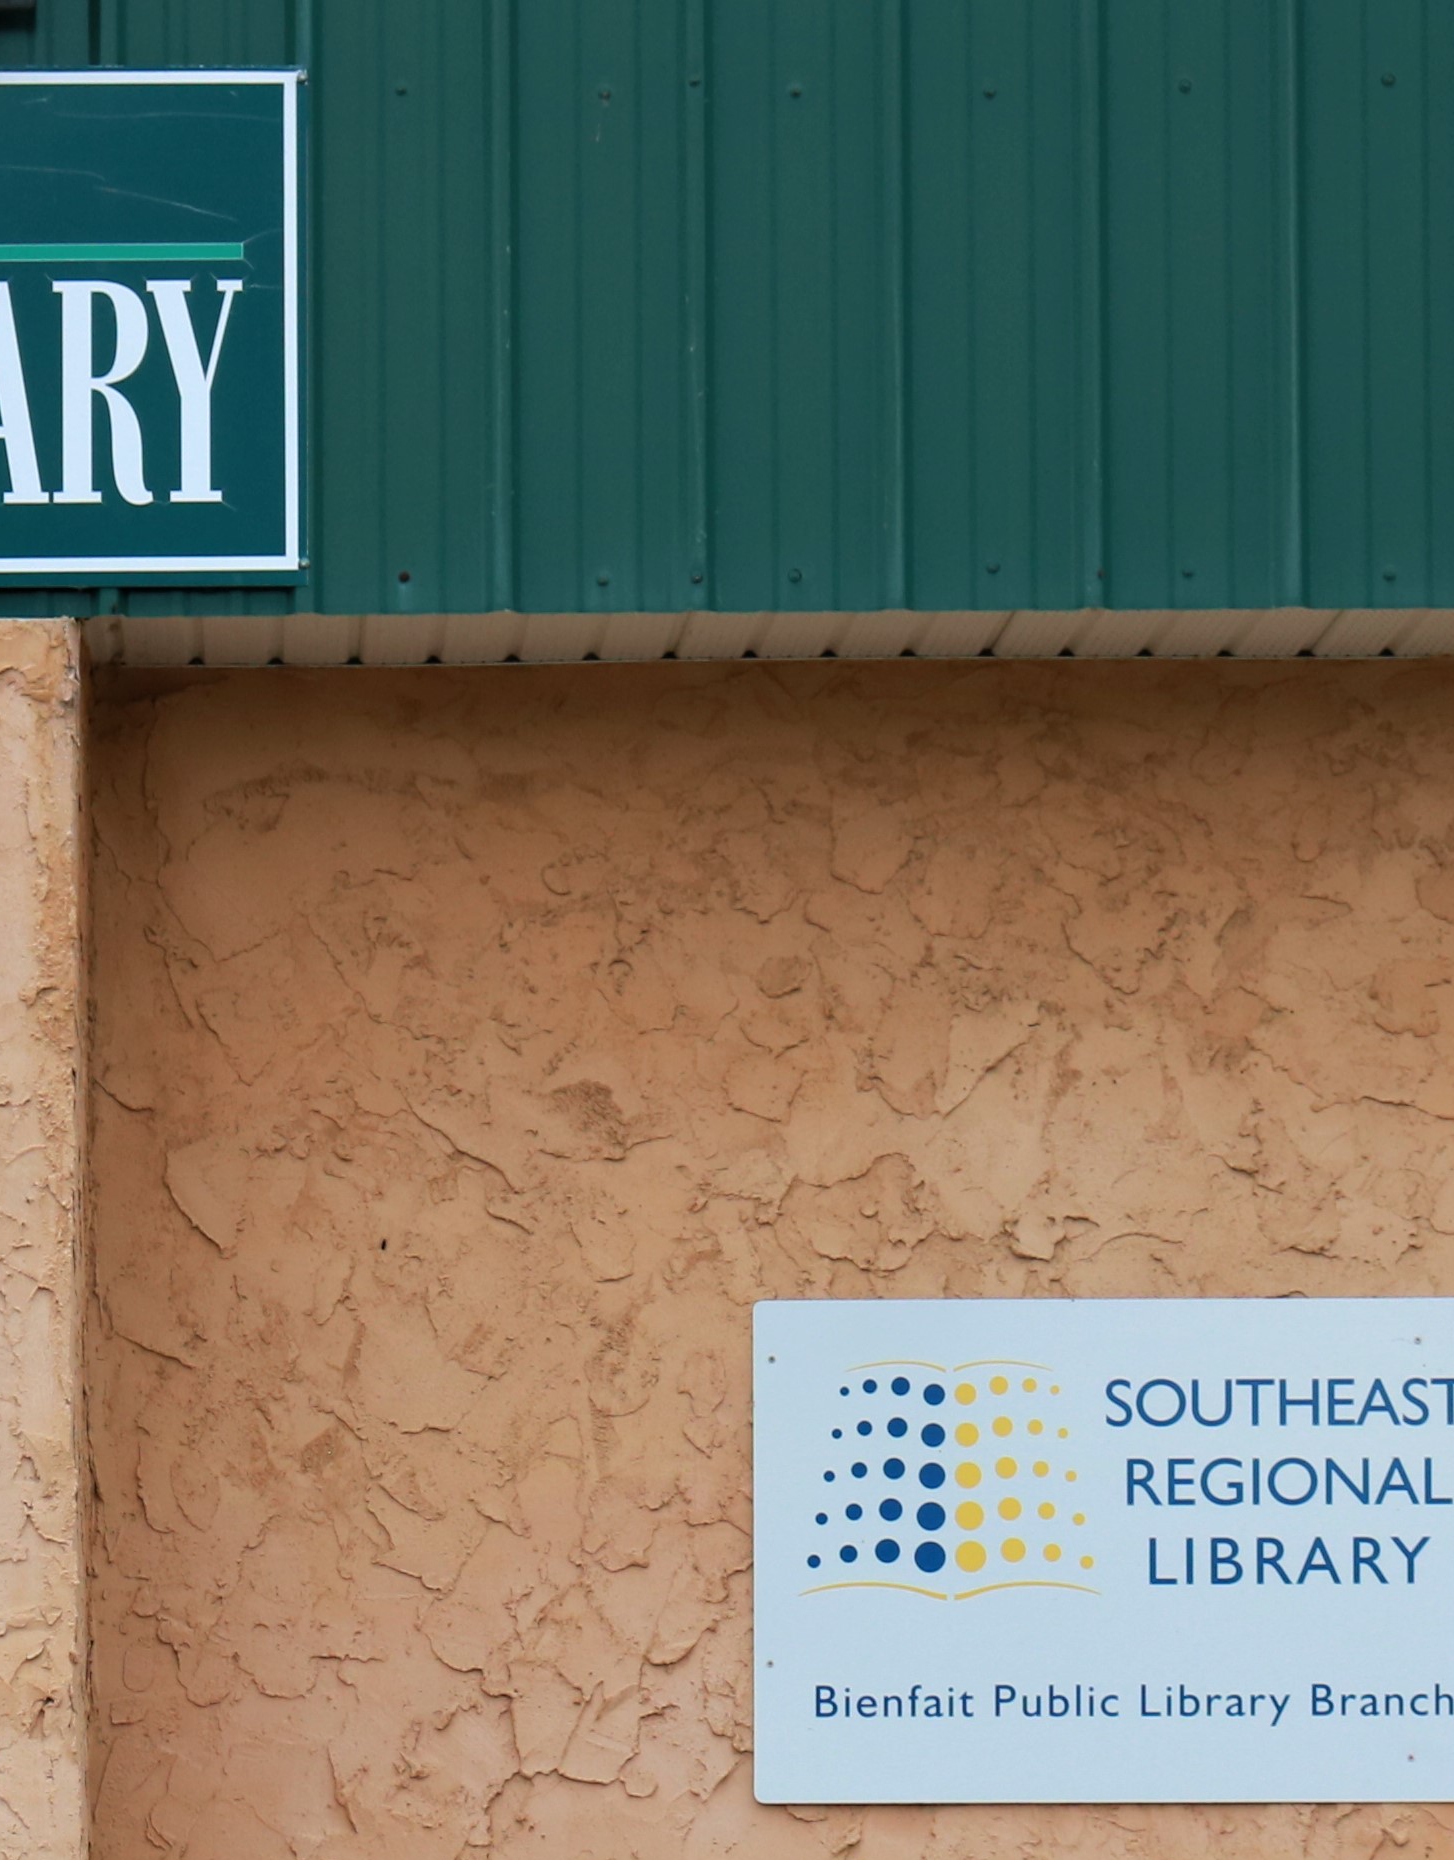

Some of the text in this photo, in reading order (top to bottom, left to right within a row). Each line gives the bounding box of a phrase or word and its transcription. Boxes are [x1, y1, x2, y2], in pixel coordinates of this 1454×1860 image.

[1126, 1458, 1453, 1507] REGIONAL
[1149, 1536, 1430, 1585] LIBRARY
[814, 1682, 1454, 1727] Bienfait Public Library Branch
